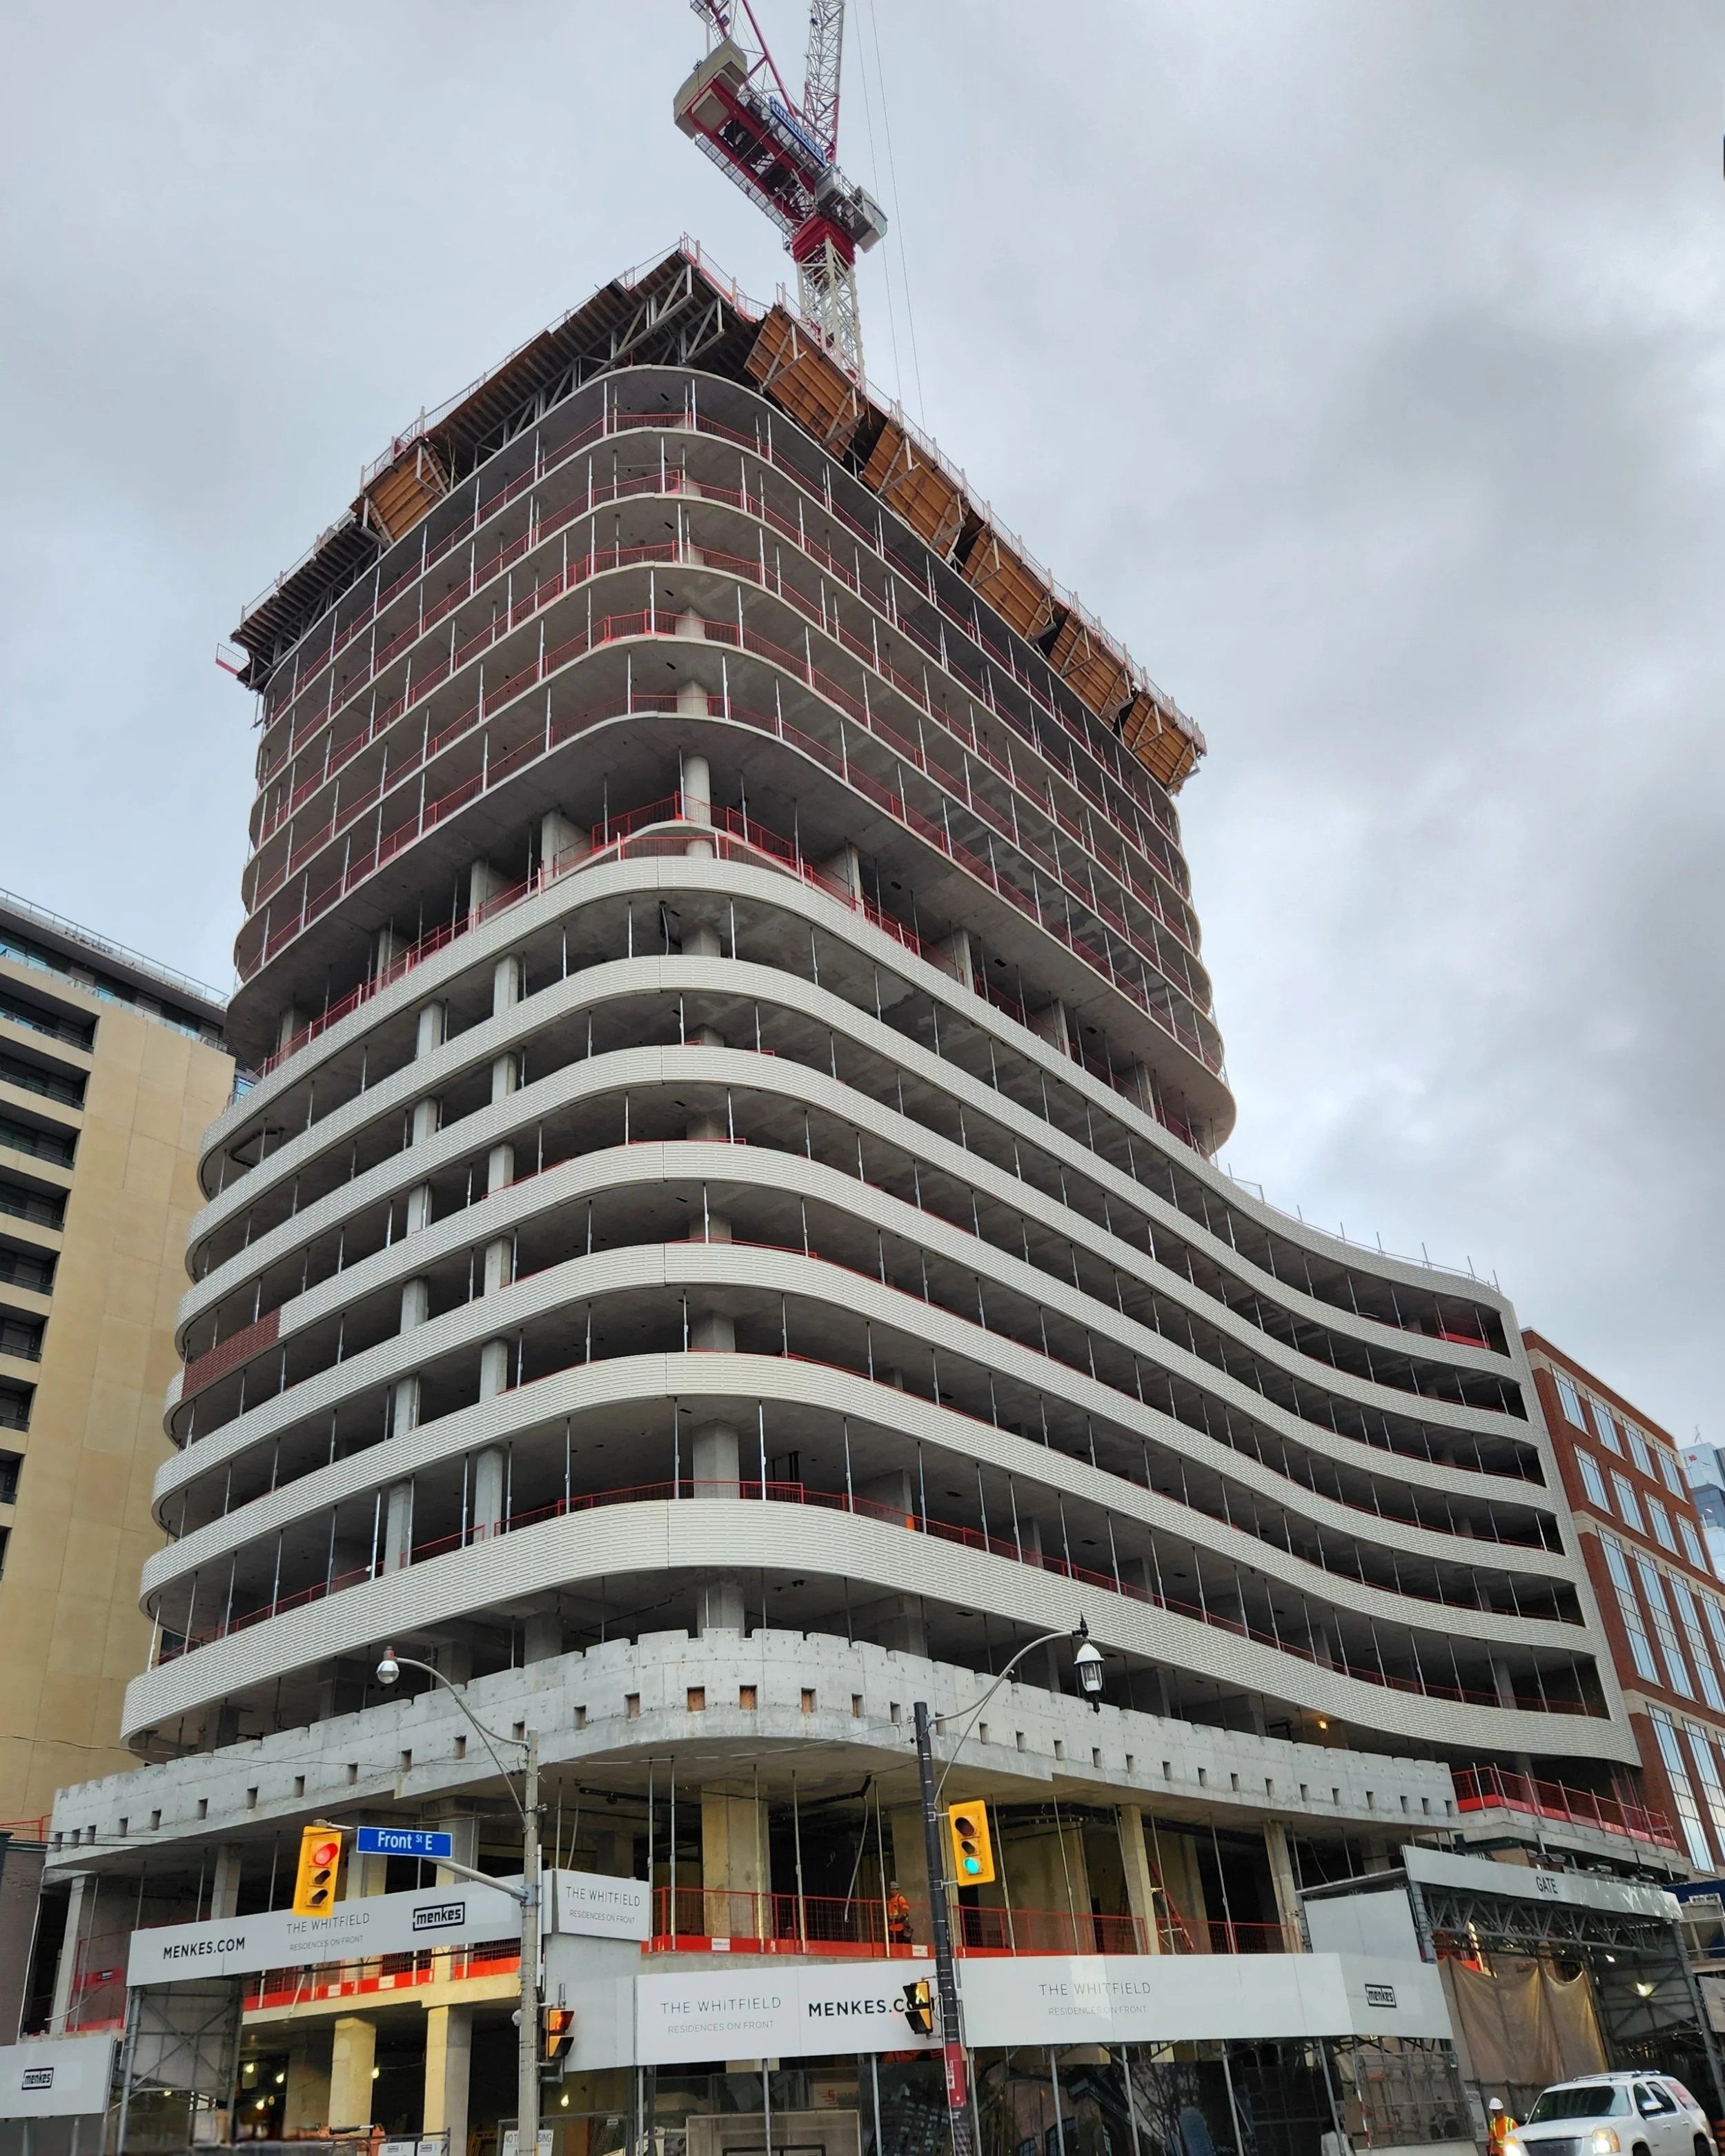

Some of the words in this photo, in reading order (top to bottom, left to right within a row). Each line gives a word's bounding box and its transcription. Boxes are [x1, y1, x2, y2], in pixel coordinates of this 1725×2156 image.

[377, 1831, 412, 1849] Front
[415, 1834, 423, 1843] St
[425, 1834, 433, 1850] E
[1536, 1876, 1558, 1894] GATE
[566, 1886, 586, 1899] THE
[589, 1889, 640, 1906] WHITFIELD
[286, 1921, 307, 1934] THE
[311, 1912, 370, 1931] WHITFIELD
[415, 1906, 462, 1926] menkes
[569, 1909, 605, 1921] RESIDENCES
[616, 1915, 635, 1924] FRONT
[163, 1937, 245, 1959] MENKES.COM
[290, 1939, 328, 1951] RESIDENCES
[330, 1938, 340, 1946] ON
[342, 1935, 364, 1945] FRONT
[1039, 1984, 1068, 1996] THE
[1074, 1982, 1151, 1995] WHITFIELD
[1368, 1987, 1394, 2002] menkes
[660, 2001, 690, 2014] THE
[697, 1997, 781, 2012] WHITFIELD
[1049, 2006, 1102, 2015] RESIDENCES
[1104, 2006, 1117, 2014] ON
[1120, 2005, 1147, 2014] FRONT
[668, 2023, 724, 2033] RESIDENCES
[727, 2021, 740, 2030] ON
[743, 2020, 773, 2030] FRONT
[24, 2070, 52, 2085] menkes
